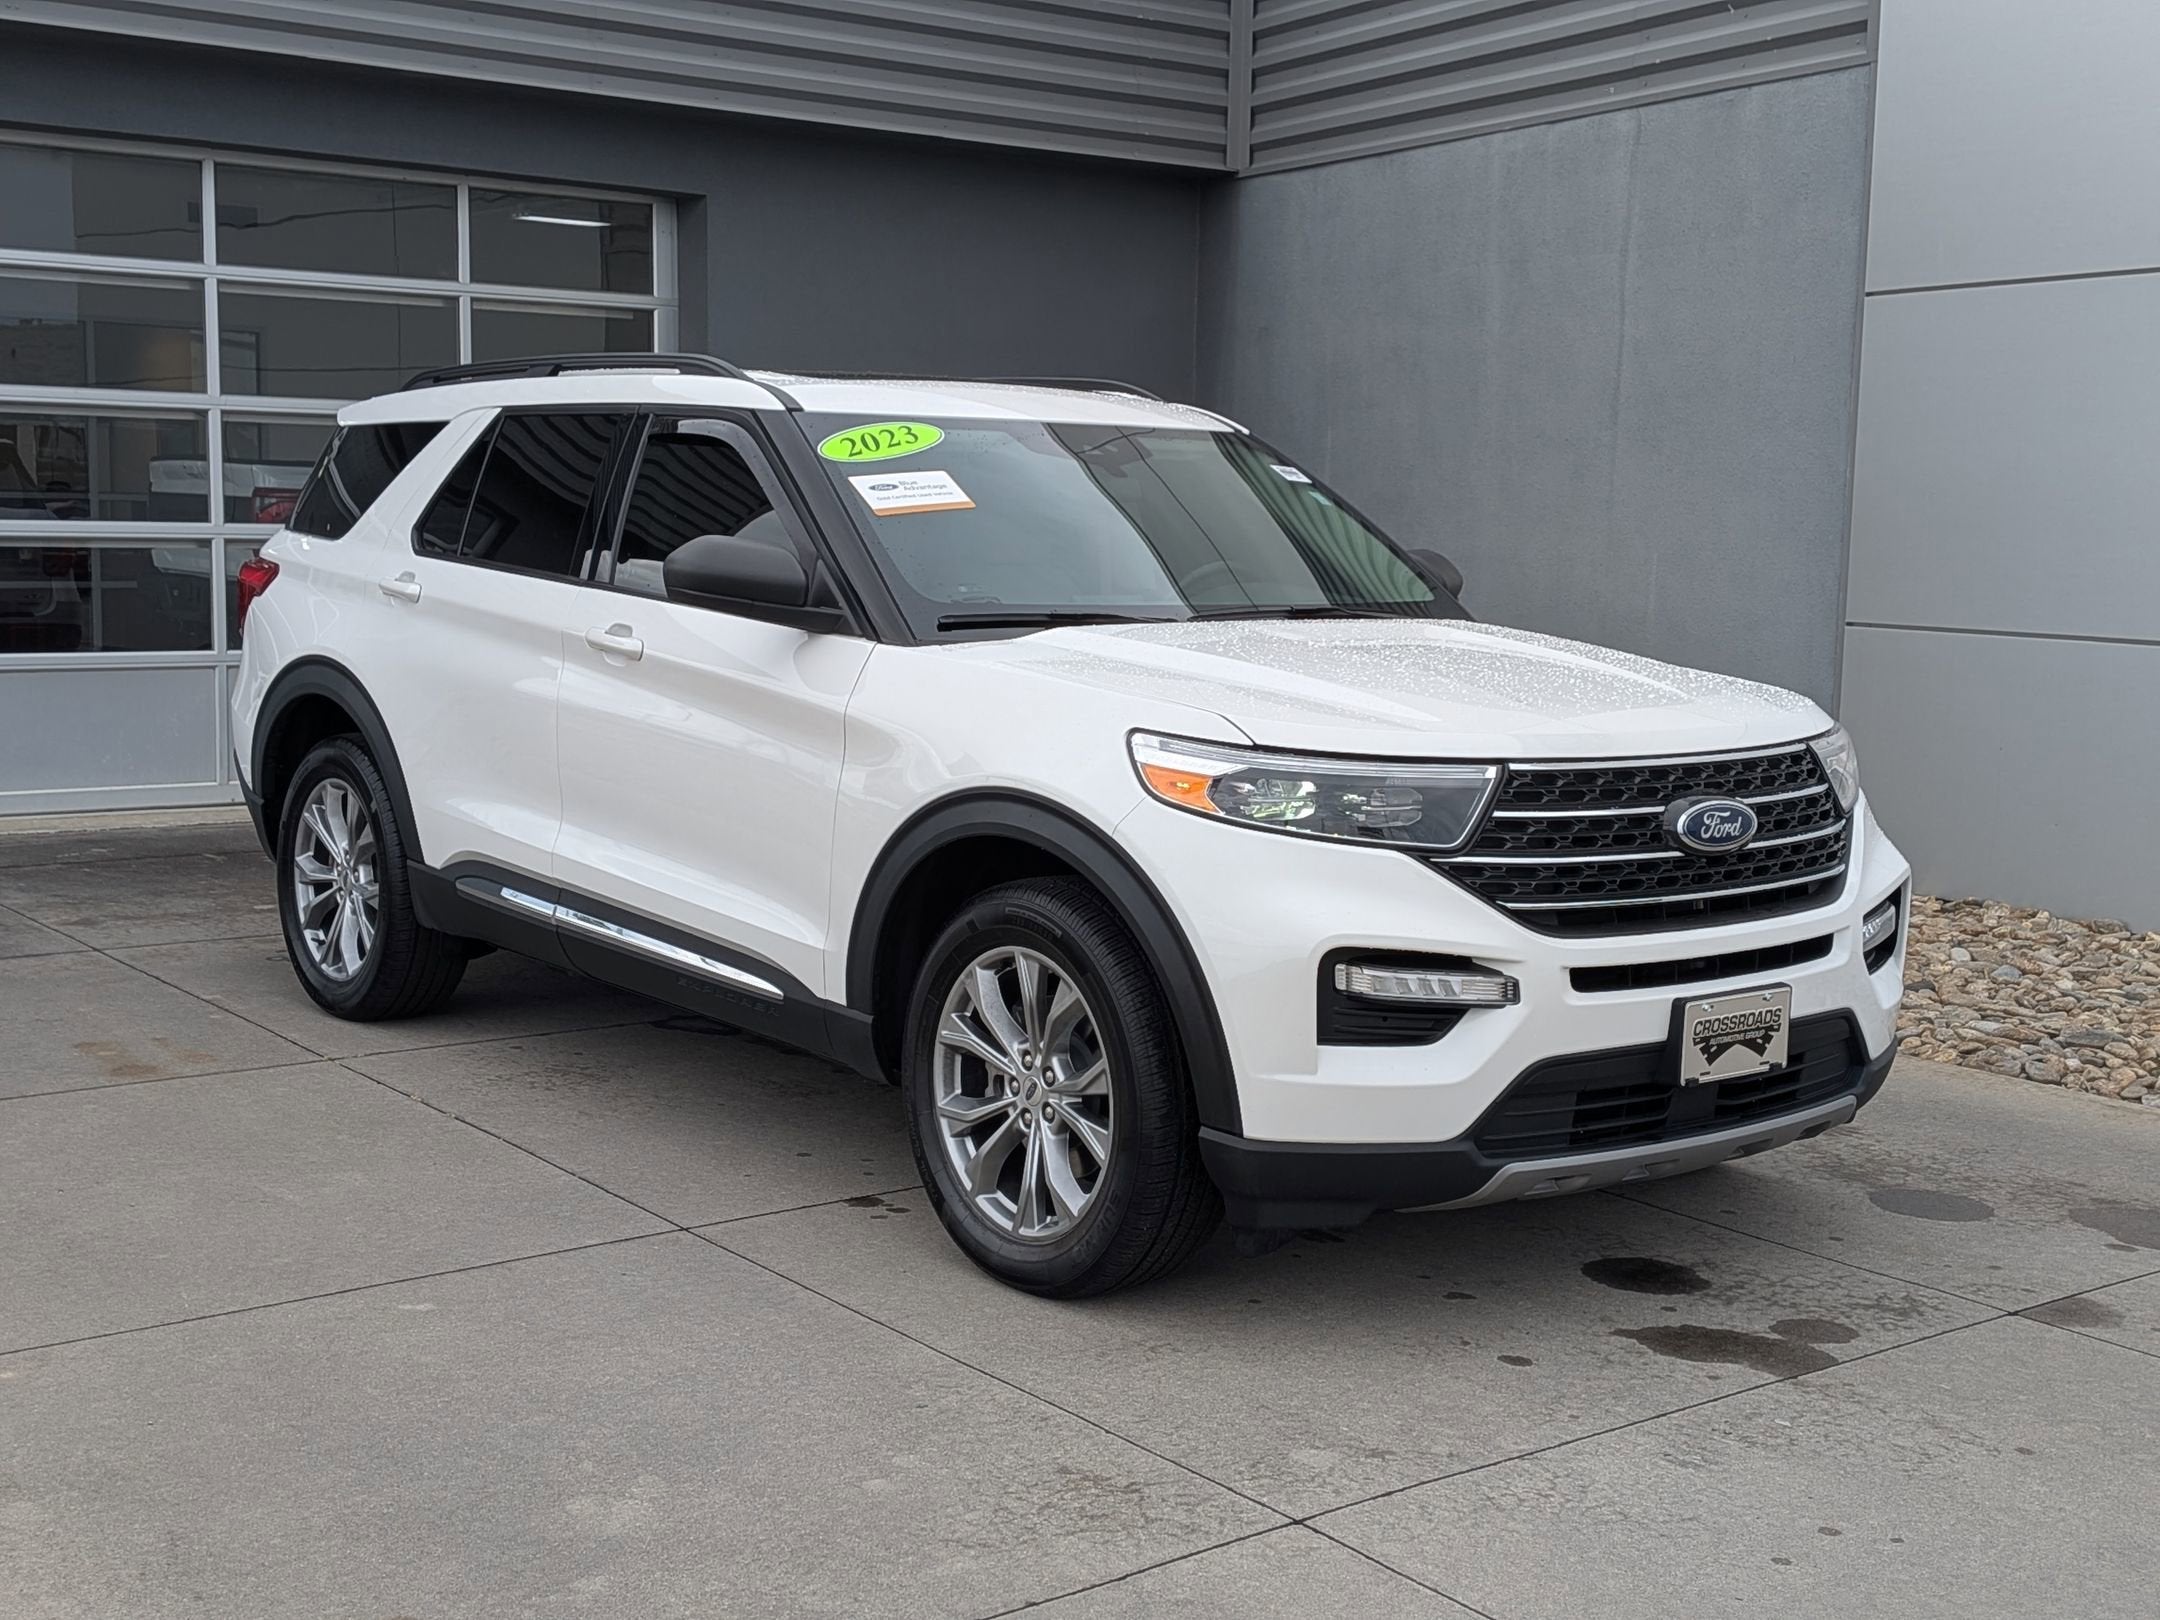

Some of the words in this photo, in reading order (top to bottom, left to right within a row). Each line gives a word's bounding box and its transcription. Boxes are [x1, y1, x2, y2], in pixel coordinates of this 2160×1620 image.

[840, 425, 919, 458] 2023
[1700, 811, 1743, 839] Ford
[1693, 1007, 1782, 1037] CROSSROADS
[1745, 1029, 1766, 1040] GROUP
